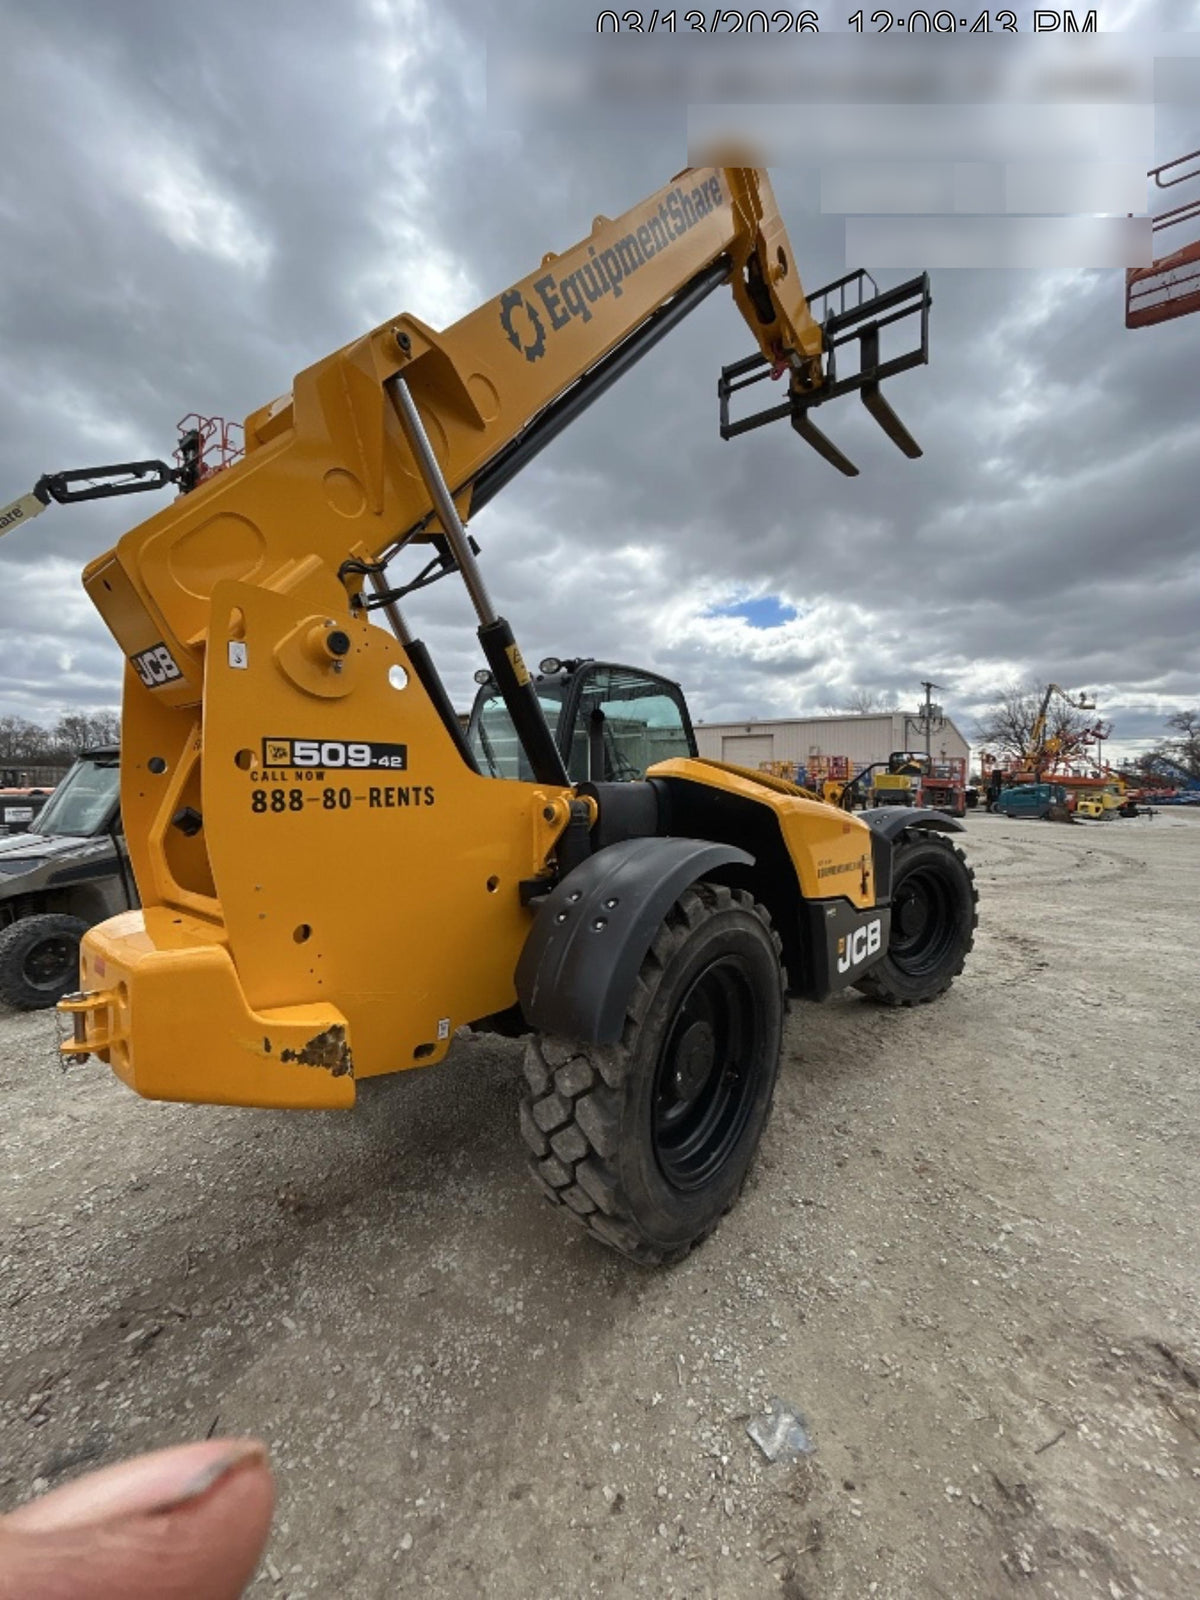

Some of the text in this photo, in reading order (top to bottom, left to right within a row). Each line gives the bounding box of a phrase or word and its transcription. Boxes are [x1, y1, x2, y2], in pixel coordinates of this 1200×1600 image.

[533, 176, 724, 332] EquipmentShare
[137, 646, 180, 686] JCB
[292, 741, 403, 767] 509-42
[250, 771, 326, 782] CALL NOW
[251, 786, 436, 813] 888-80-RENTS
[837, 918, 881, 974] JCB
